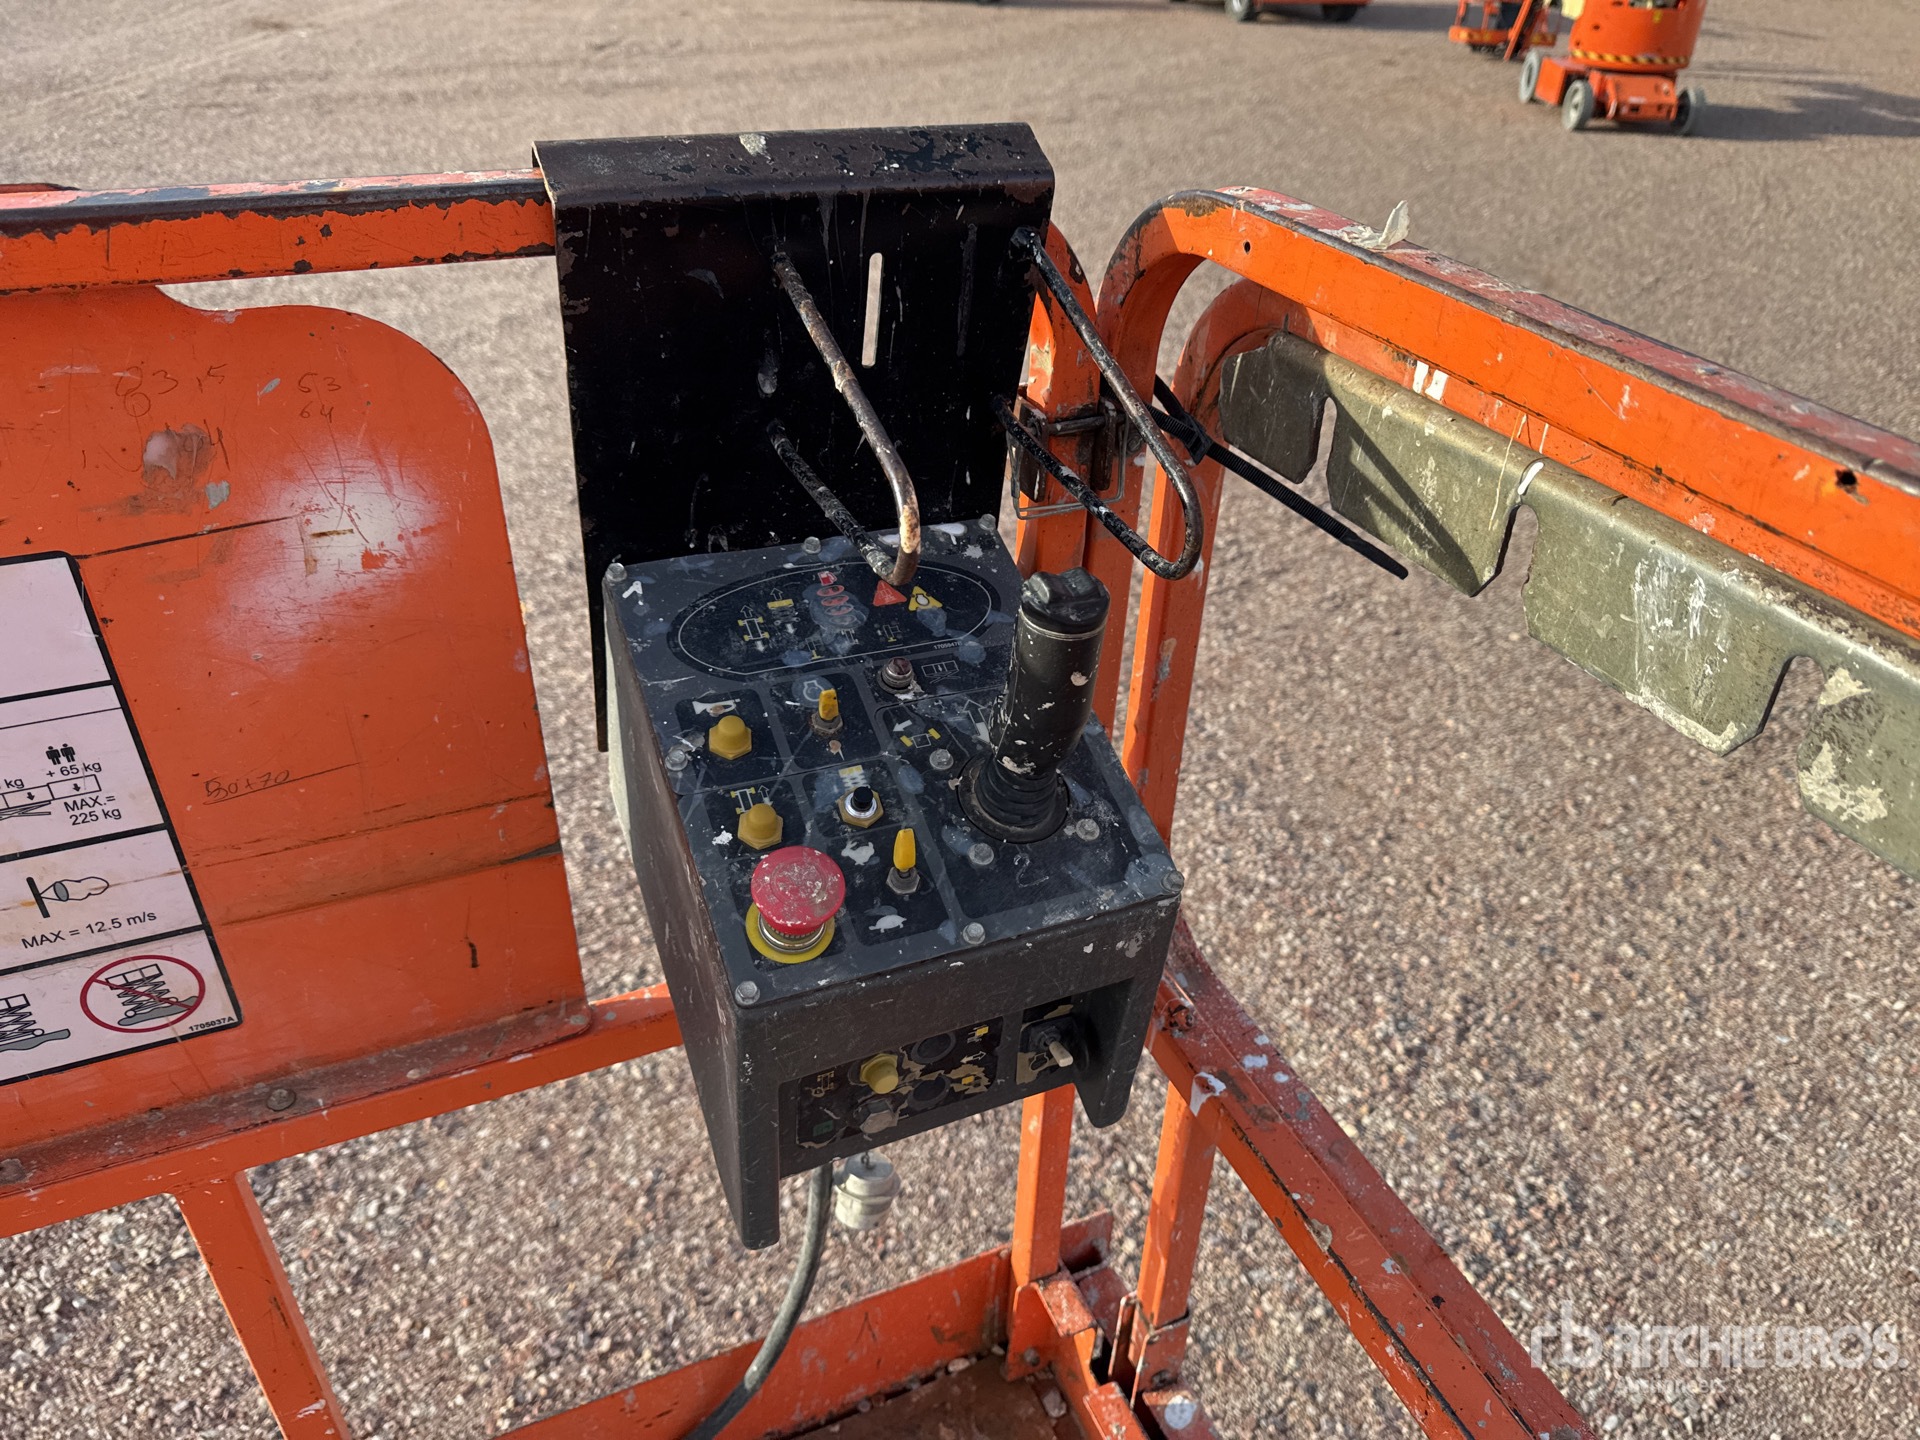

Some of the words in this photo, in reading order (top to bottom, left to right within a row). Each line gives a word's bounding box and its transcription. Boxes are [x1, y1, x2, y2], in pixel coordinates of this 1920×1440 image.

[60, 764, 79, 776] 65
[82, 762, 102, 773] kg
[4, 778, 25, 790] kg
[69, 811, 99, 826] 225
[102, 808, 122, 820] kg
[21, 930, 66, 949] MAX
[86, 918, 122, 934] 12.5
[126, 911, 157, 926] m/s
[189, 1016, 235, 1031] 1705037A
